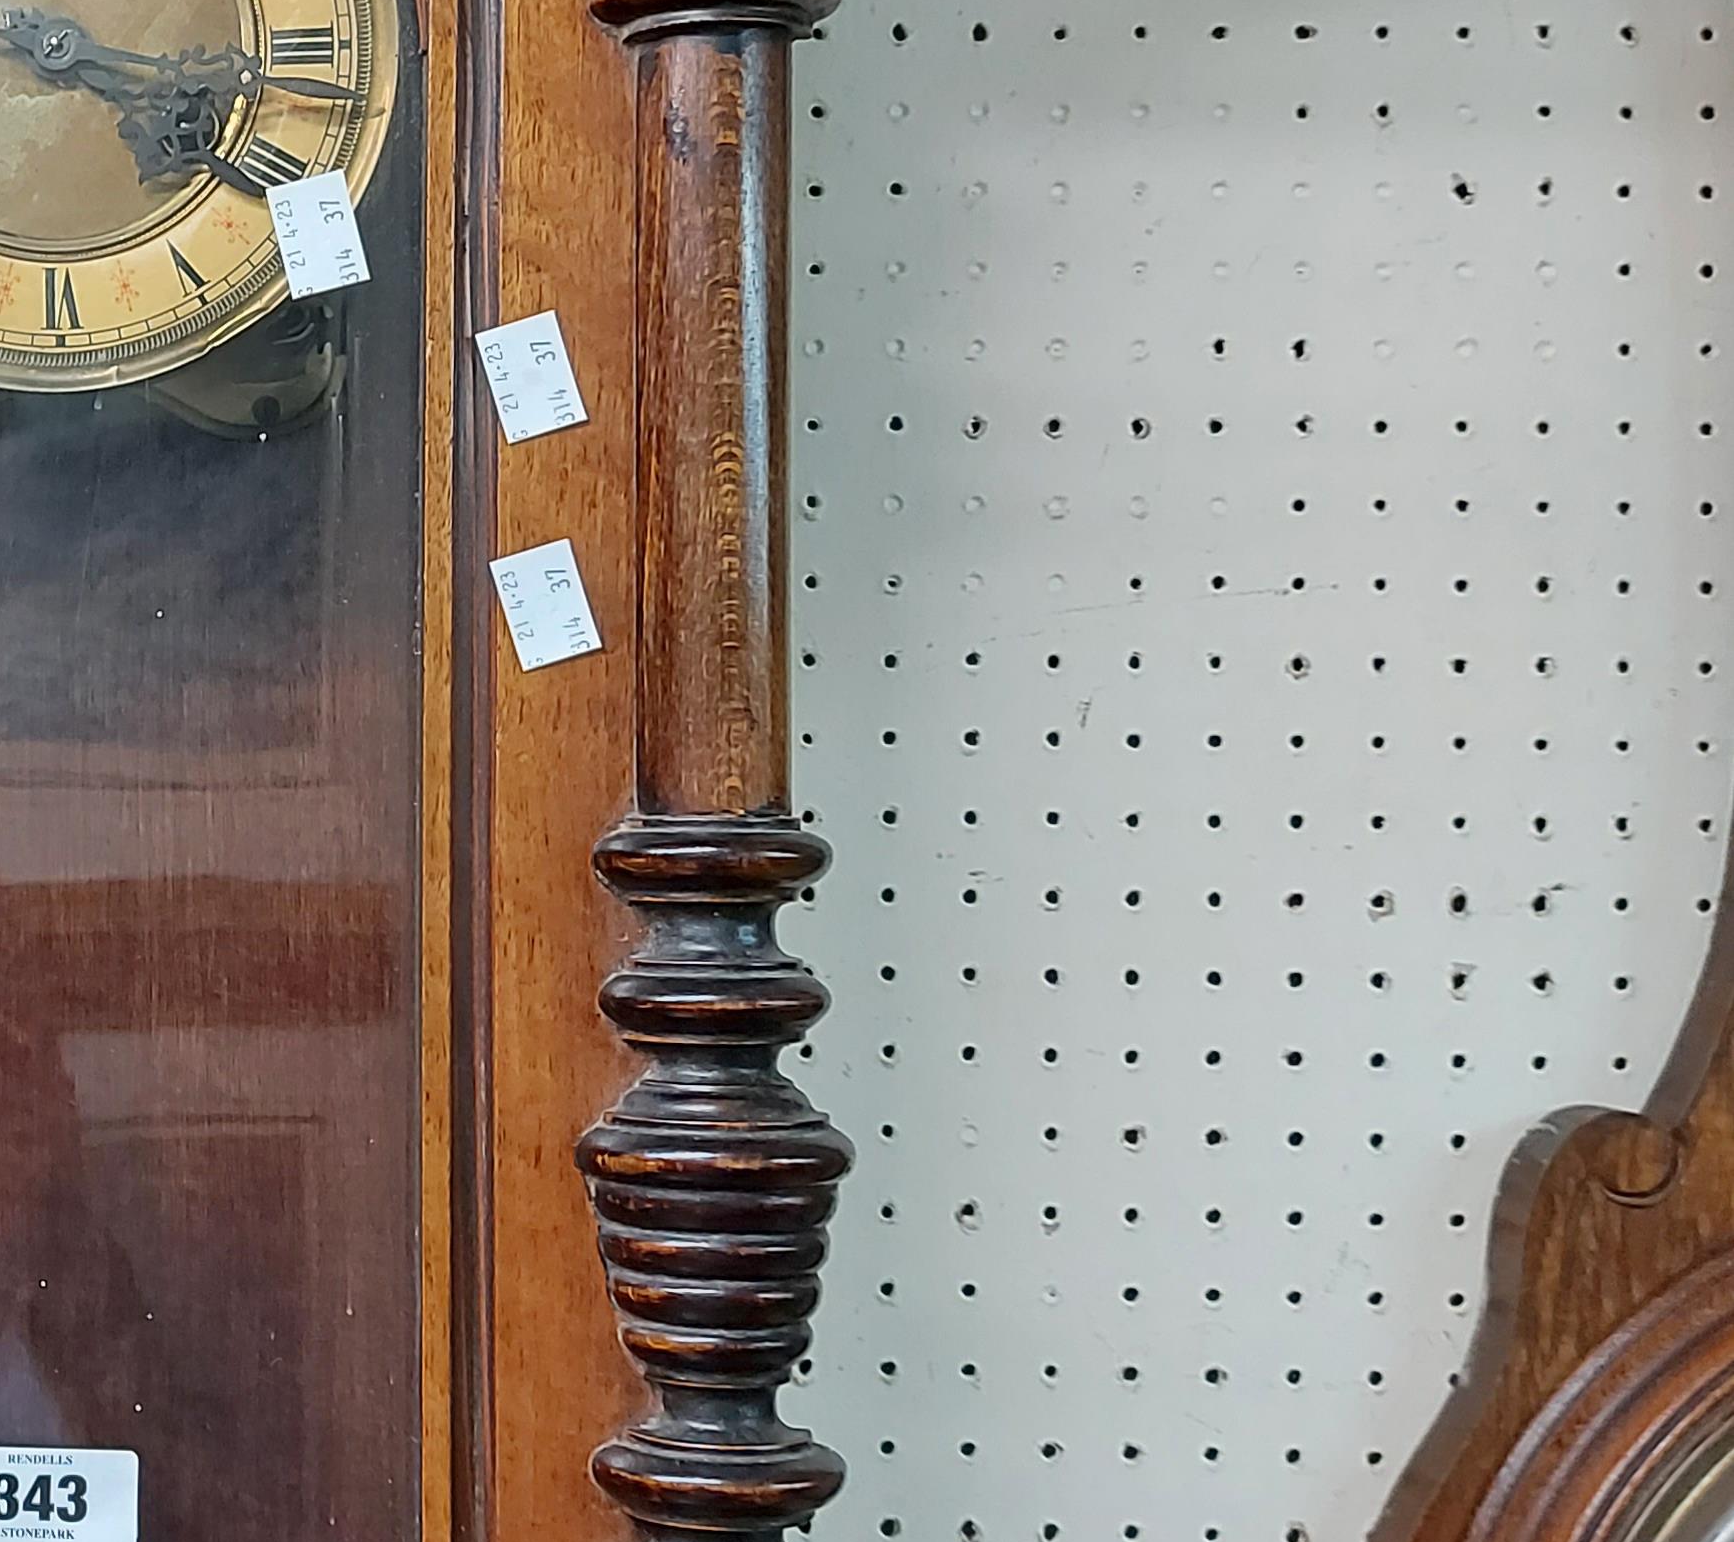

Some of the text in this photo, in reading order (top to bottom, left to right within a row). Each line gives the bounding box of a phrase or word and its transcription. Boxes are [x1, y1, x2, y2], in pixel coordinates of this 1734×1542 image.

[270, 20, 334, 71] III
[319, 201, 344, 224] 37
[168, 239, 209, 297] V
[42, 267, 83, 331] VI
[529, 341, 556, 365] 37
[545, 569, 570, 593] 37
[8, 1454, 74, 1466] RENDELLS
[0, 1528, 75, 1540] STONEPARK
